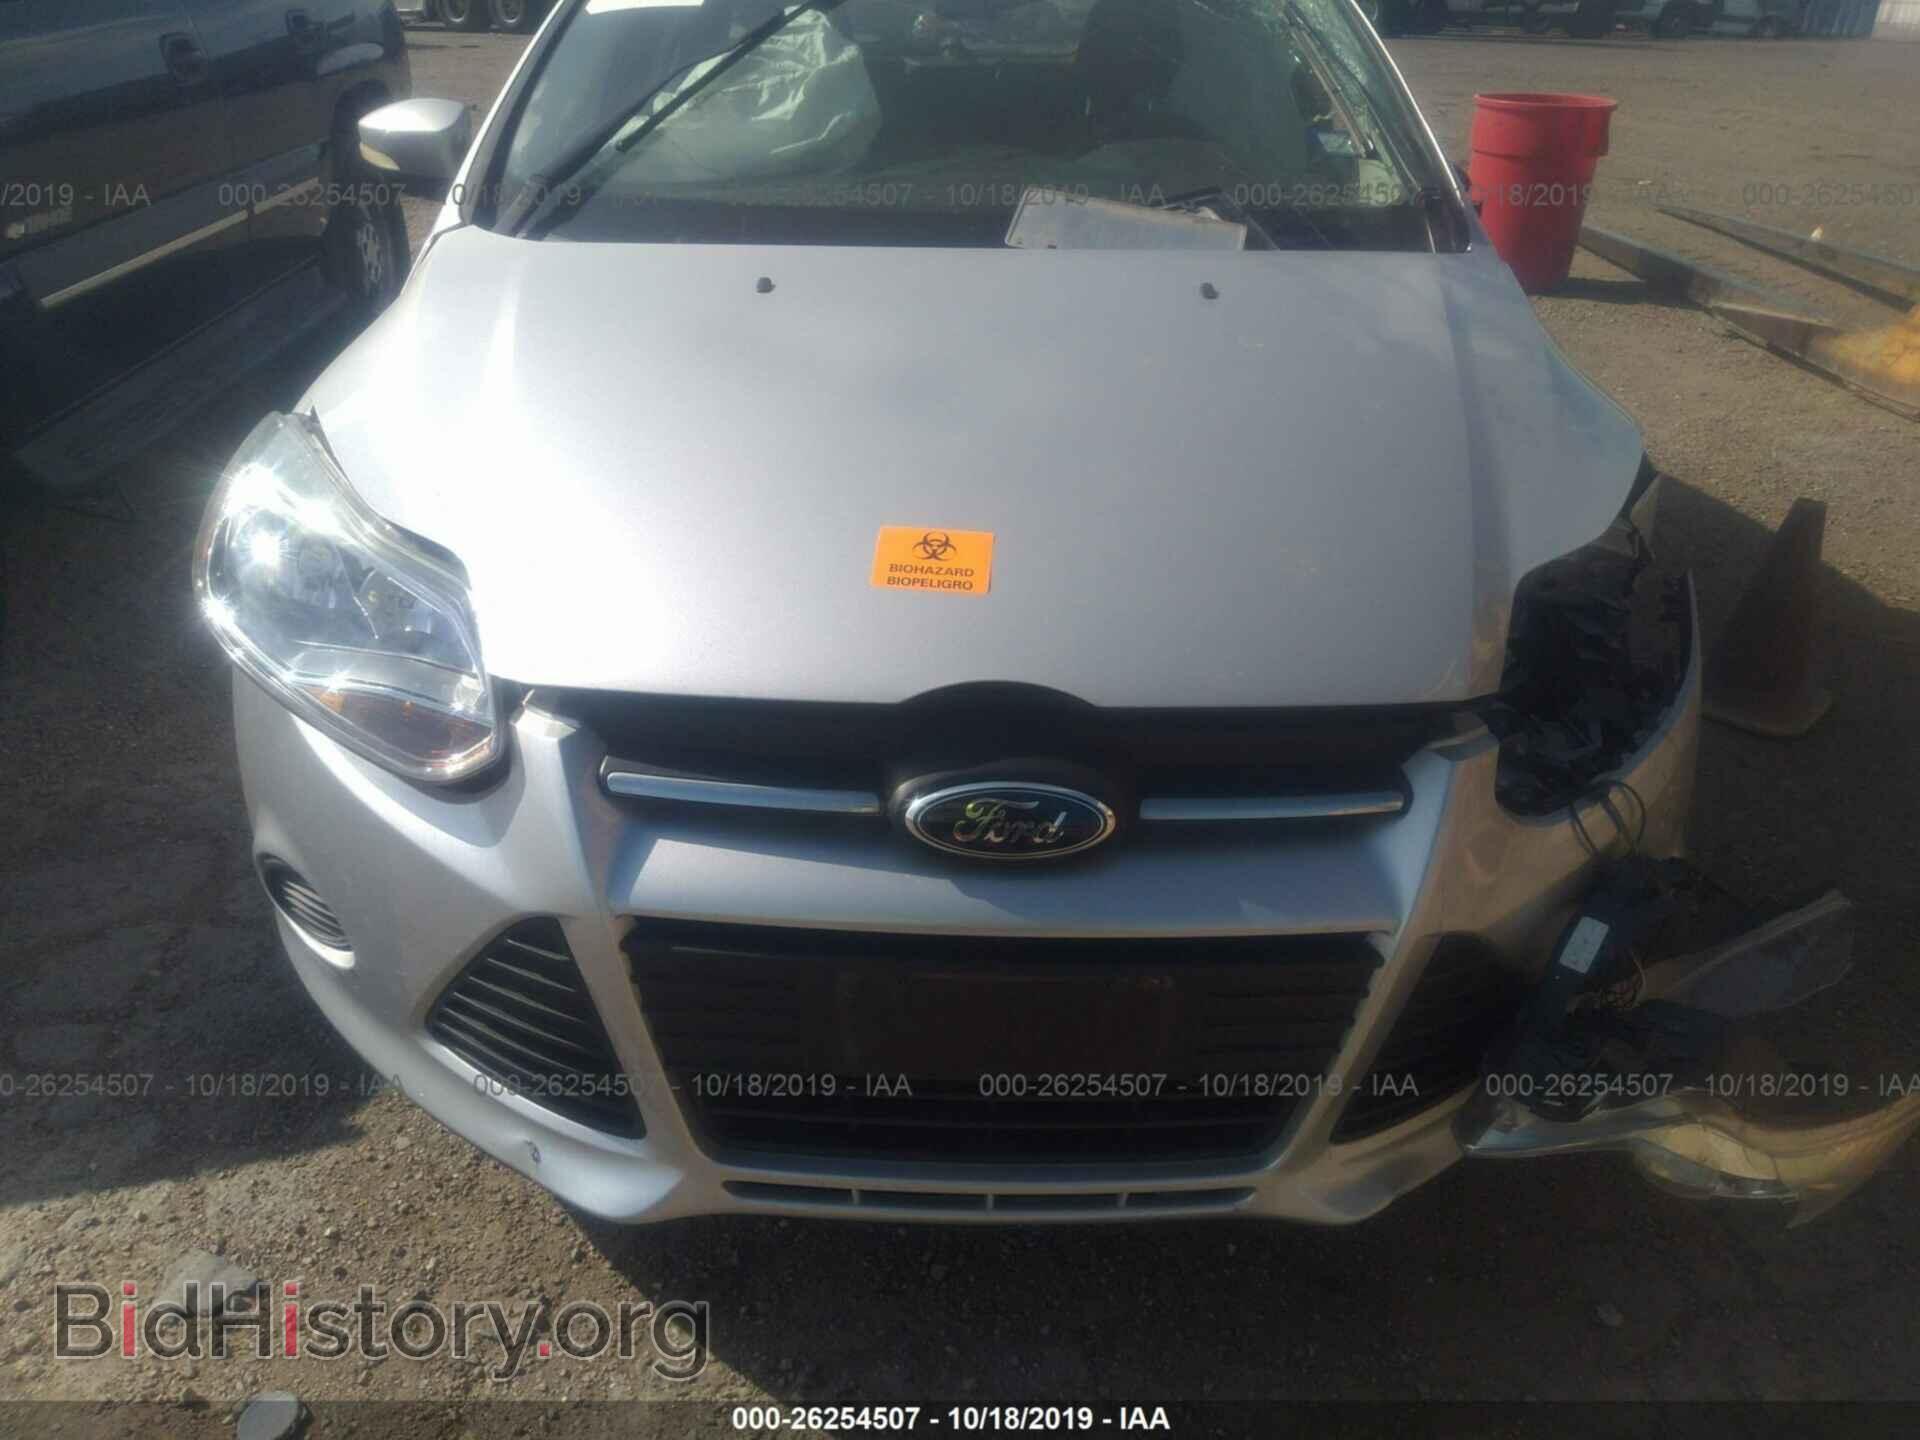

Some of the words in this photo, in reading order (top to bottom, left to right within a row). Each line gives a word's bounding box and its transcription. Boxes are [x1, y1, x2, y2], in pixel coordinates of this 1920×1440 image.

[888, 563, 975, 577] BIOHAZARD
[886, 576, 974, 590] BIOPELIGRO
[953, 797, 1068, 843] Ford
